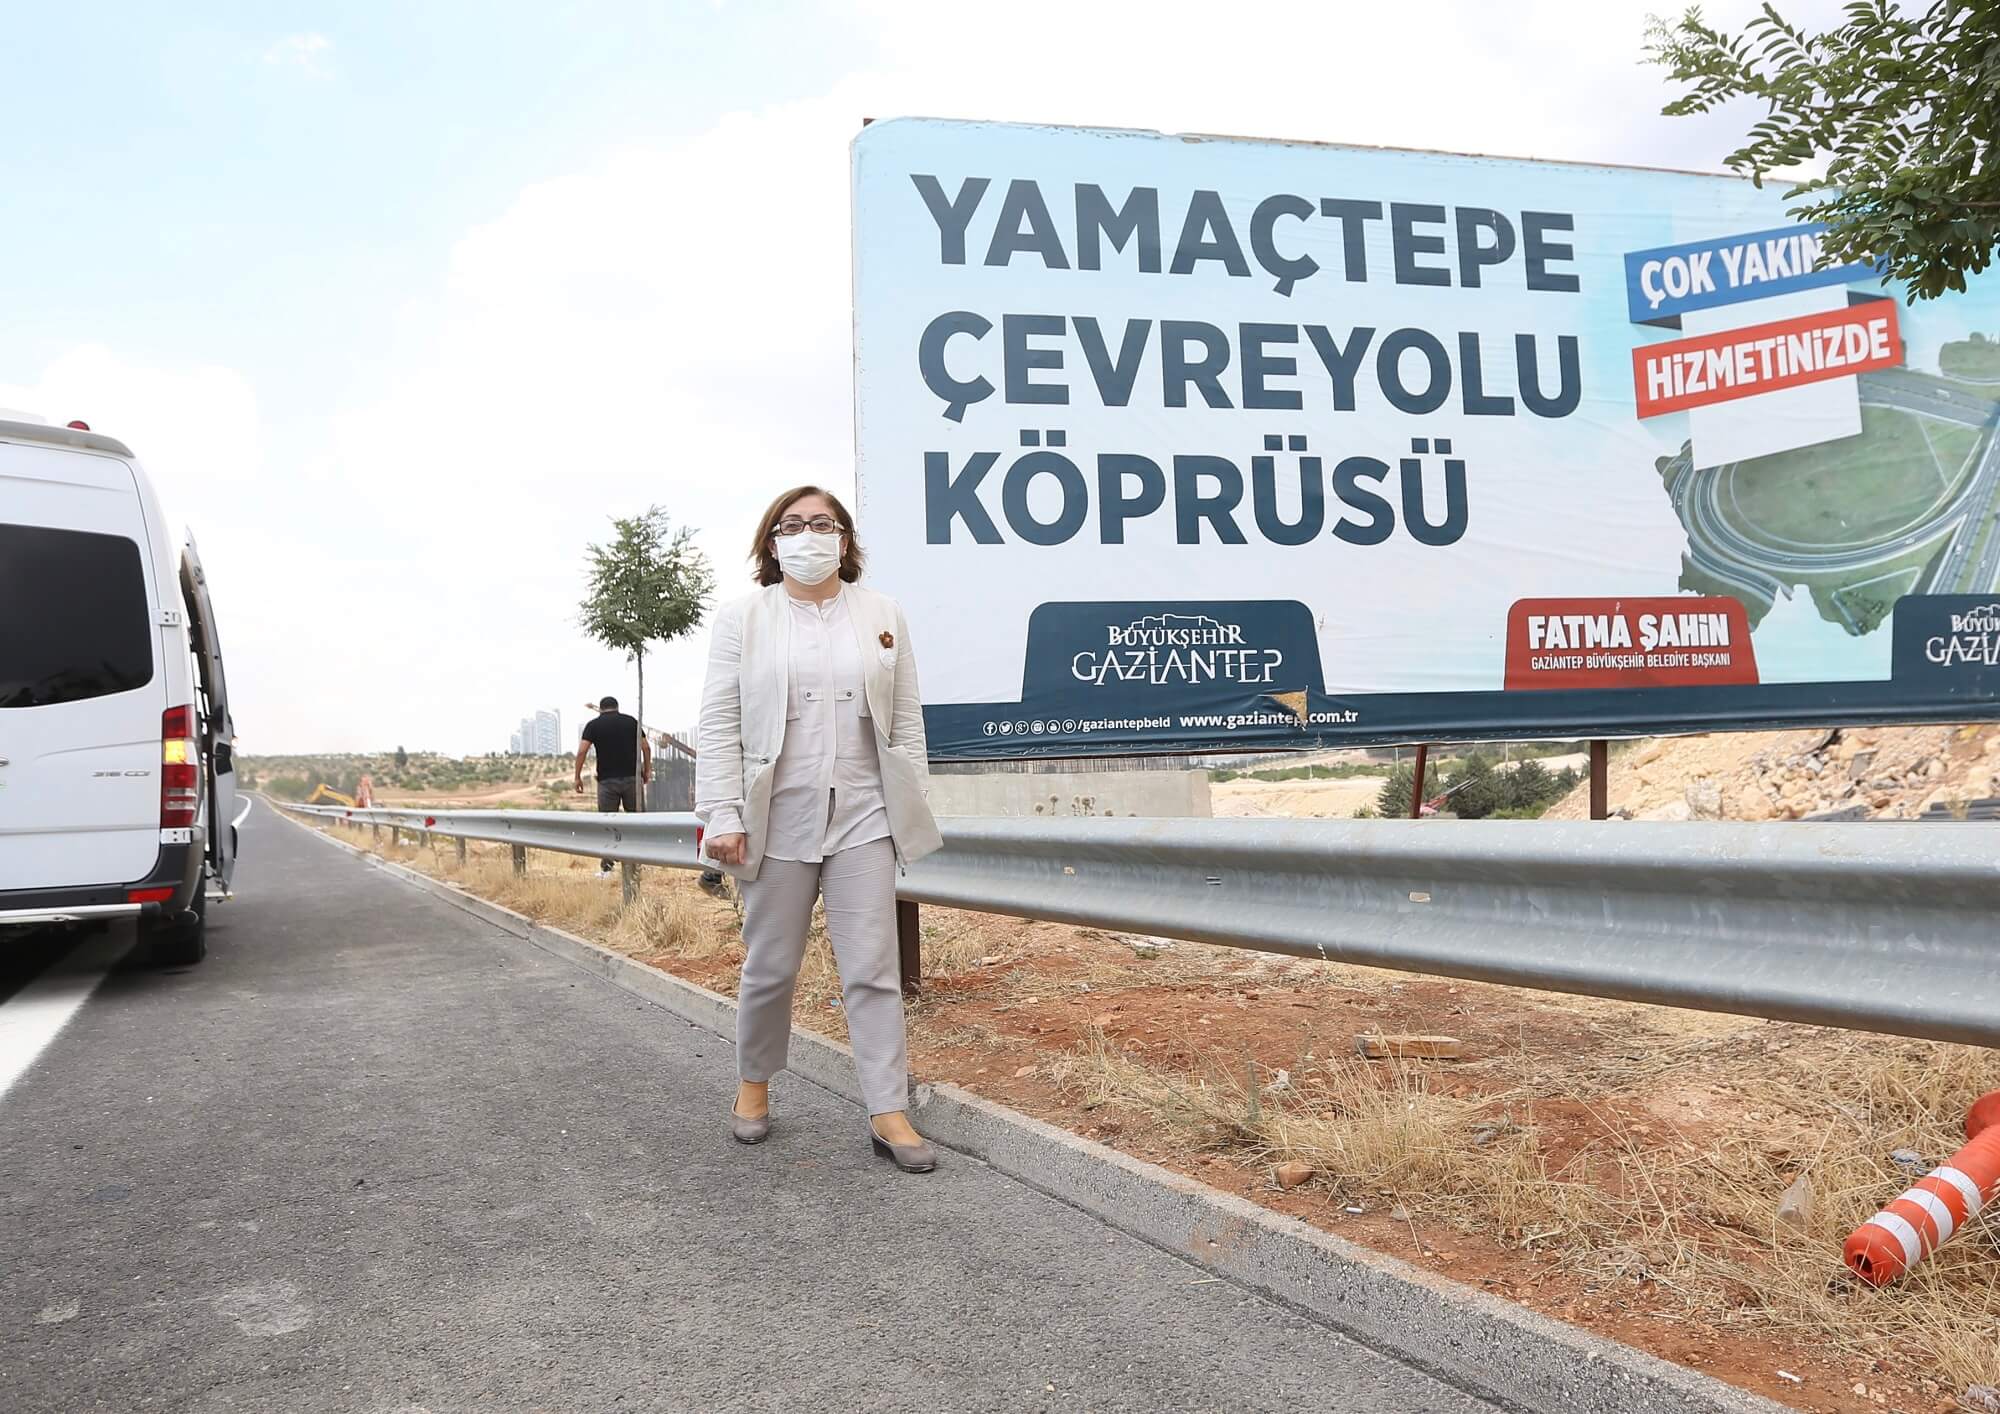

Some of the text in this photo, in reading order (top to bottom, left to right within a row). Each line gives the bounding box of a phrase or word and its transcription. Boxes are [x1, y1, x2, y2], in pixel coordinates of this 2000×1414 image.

[910, 173, 1581, 298] YAMAÇTEPE
[1640, 231, 1873, 310] ÇOK YAKIN
[918, 310, 1582, 423] ÇEVREYOLU
[1646, 317, 1891, 401] HİZMETİNİZDE
[923, 429, 1469, 546] KÖPRÜSÜ
[1107, 624, 1247, 649] BÜYÜKŞEHİR
[1528, 613, 1730, 652] FATMA ŞAHİN
[1531, 650, 1731, 671] GAZİANTEP BÜYÜKŞEHİR BELEDİYE BAŞKANI
[1071, 646, 1283, 685] GAZİANTEP
[1077, 716, 1171, 732] /gaziantepbeld
